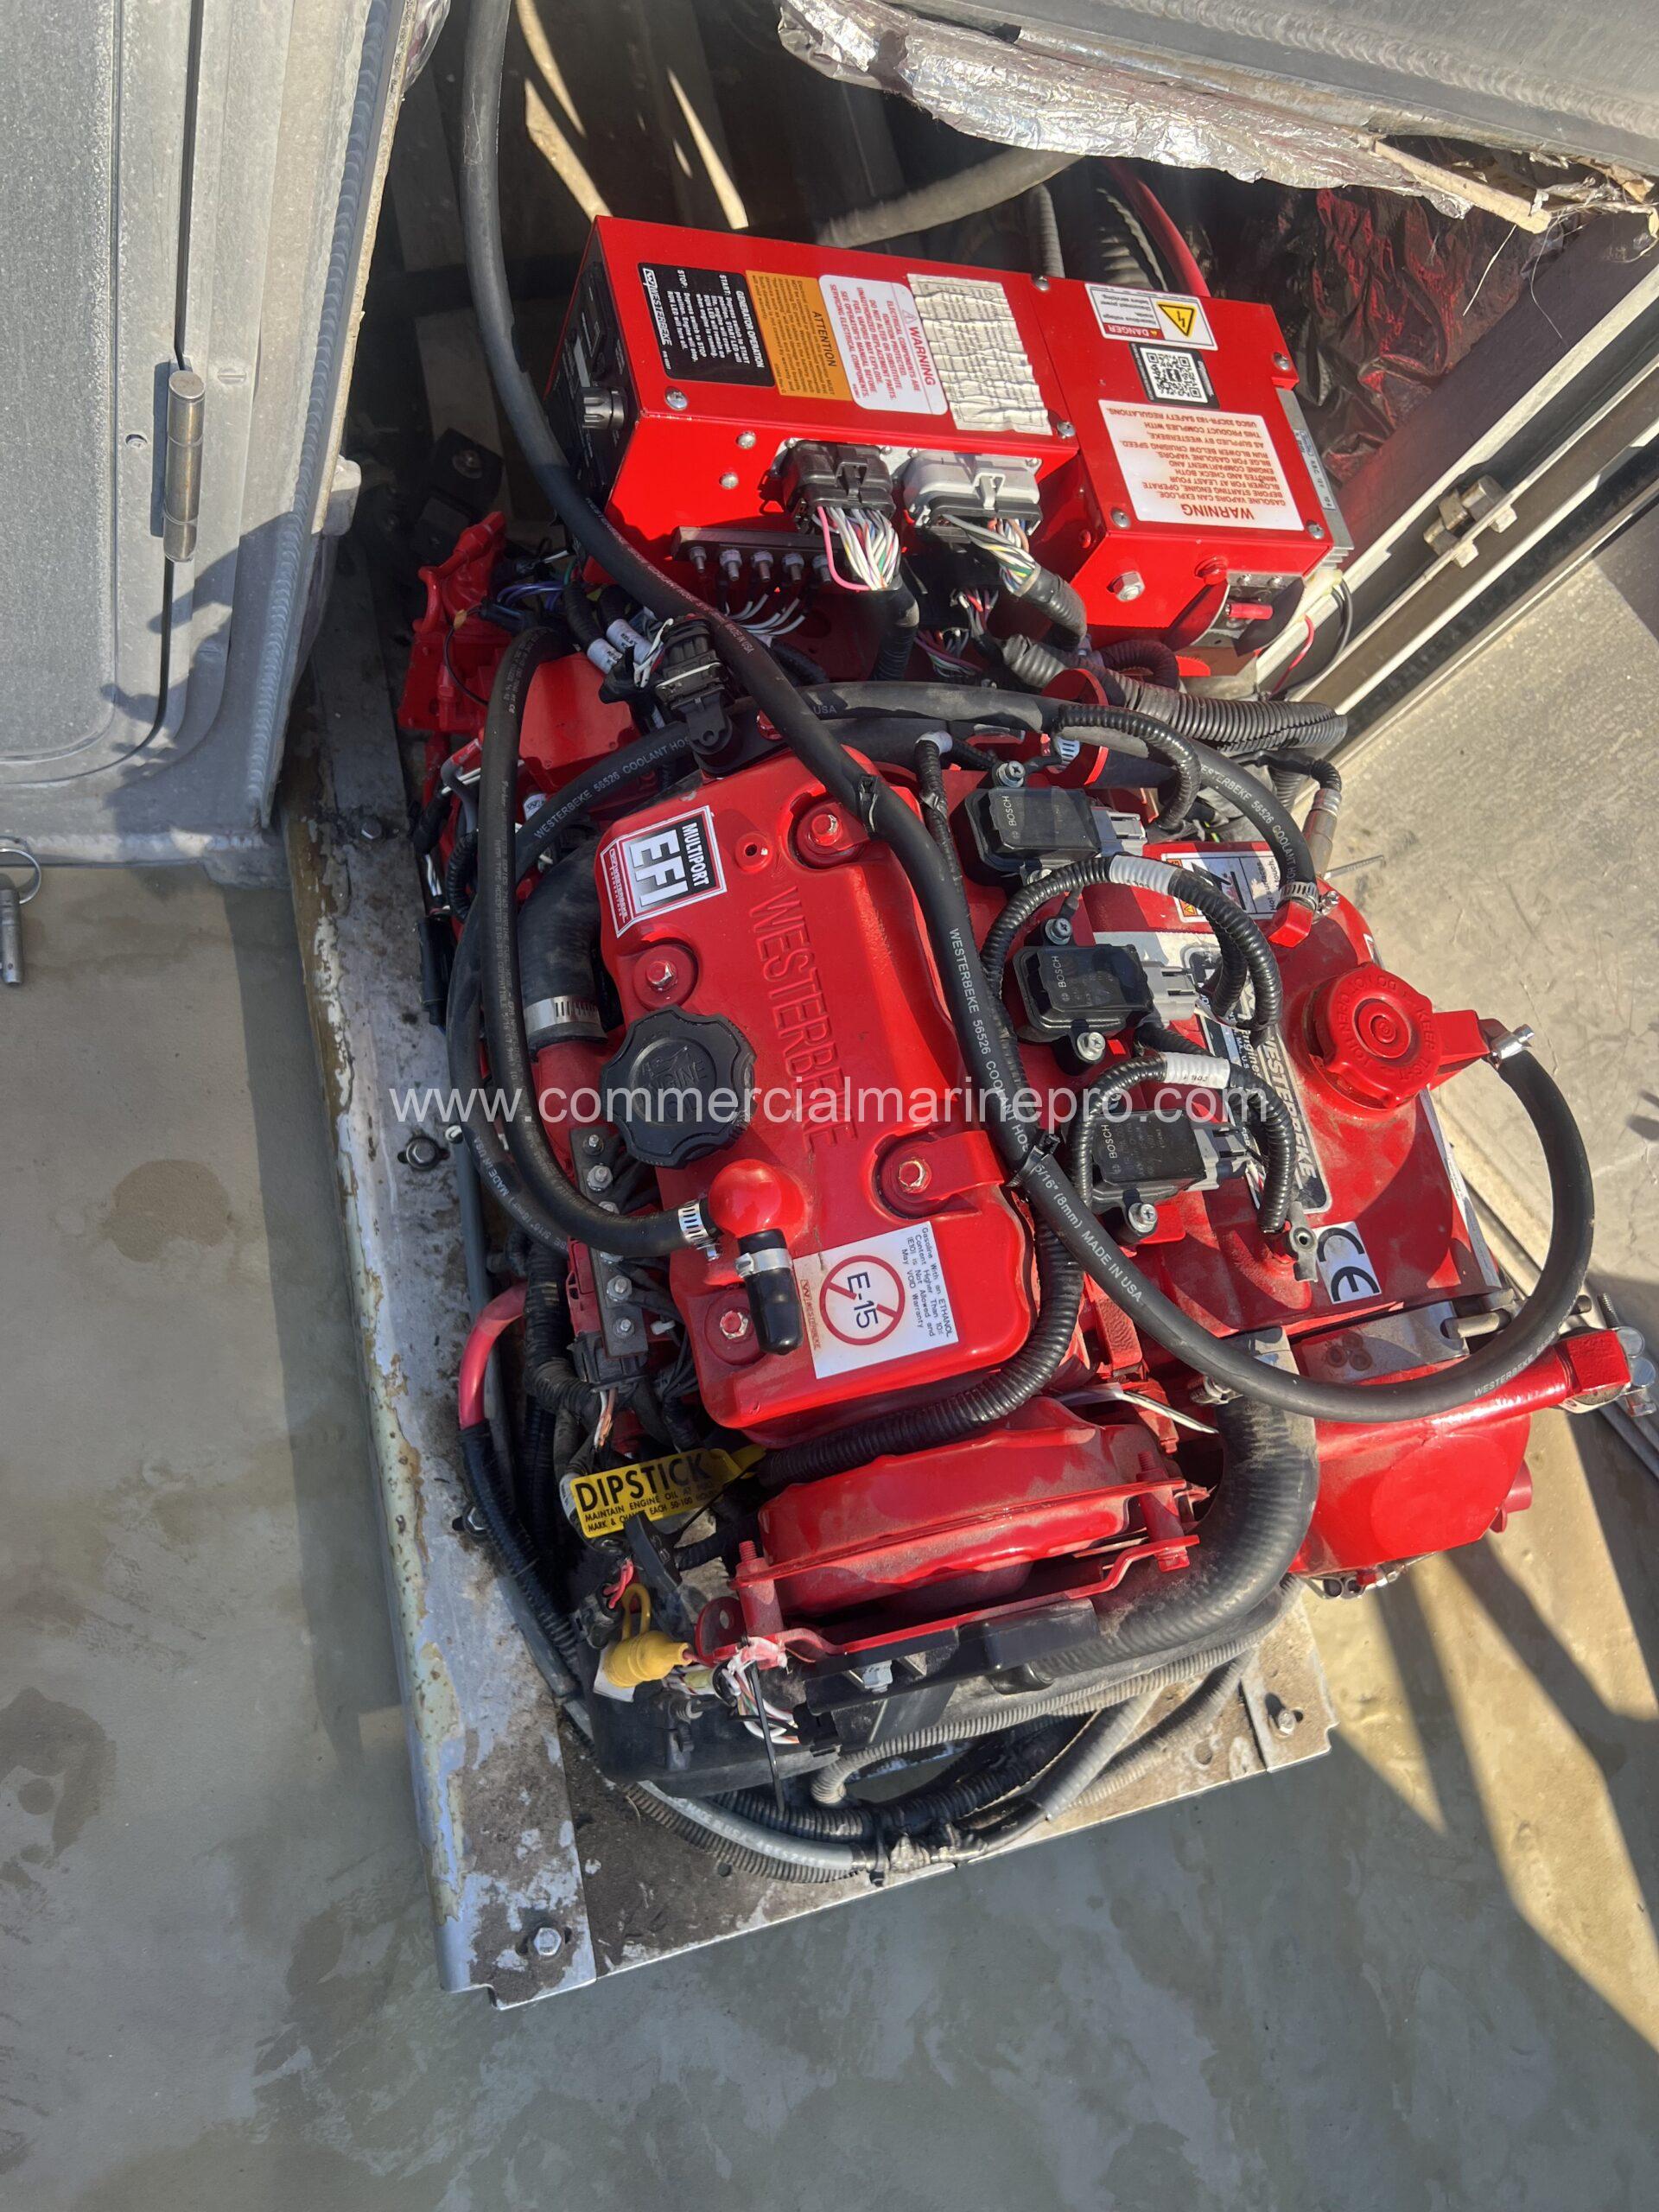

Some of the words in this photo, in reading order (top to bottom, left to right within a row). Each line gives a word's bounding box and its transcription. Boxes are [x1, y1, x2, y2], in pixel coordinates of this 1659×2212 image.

[667, 290, 676, 302] RUN
[671, 304, 679, 315] LED
[648, 287, 672, 346] WESTERBEKE
[677, 270, 687, 288] STOP:
[683, 292, 694, 315] Depress
[690, 315, 699, 334] switch
[696, 342, 707, 357] STOP
[682, 316, 691, 335] Engine
[700, 308, 709, 327] engine
[707, 308, 715, 319] LED
[714, 331, 722, 349] remain
[714, 307, 723, 326] engine
[719, 275, 731, 296] START:
[726, 297, 736, 318] Depress
[732, 320, 741, 337] switch
[737, 345, 749, 364] START
[725, 321, 735, 339] START
[736, 290, 753, 329] GENERATOR
[747, 330, 764, 367] OPERATION
[830, 284, 844, 315] SERVICING
[840, 316, 855, 352] ELECTRICAL
[882, 314, 895, 340] IGNITION
[1107, 324, 1149, 336] DANGER
[812, 311, 836, 366] ATTENTION
[857, 288, 876, 333] UNAUTHORIZED
[871, 334, 890, 377] REPLACEMENT
[857, 316, 869, 340] VAPORS
[865, 341, 874, 354] MAY
[877, 323, 887, 340] ALTER
[883, 342, 890, 351] OR
[887, 301, 902, 334] ELECTRICAL
[899, 337, 915, 378] COMPONENTS
[856, 342, 868, 366] MANUAL
[864, 369, 876, 391] BEFORE
[886, 353, 901, 387] SUBSTITUTE
[909, 327, 936, 385] WARNING
[1166, 423, 1205, 433] COMPLIES
[1207, 428, 1243, 436] PRODUCT
[1216, 438, 1253, 448] SUPPLIED
[1150, 442, 1187, 452] CRUISING
[1191, 454, 1230, 463] GASOLINE
[1187, 462, 1244, 472] COMPARTMENT
[1243, 474, 1277, 482] MINUTES
[1142, 482, 1179, 491] OPERATE
[1213, 487, 1251, 496] STARTING
[1180, 504, 1255, 519] WARNING
[724, 622, 741, 637] MADE
[742, 640, 754, 654] USA
[811, 703, 837, 715] USA
[534, 790, 594, 840] WESTERBEKE
[594, 771, 620, 791] 56526
[622, 746, 669, 774] COOLANT
[1001, 794, 1019, 828] BOSCH
[1251, 800, 1274, 824] 56526
[1272, 824, 1297, 868] COOLANT
[628, 830, 688, 906] EFI
[682, 823, 709, 887] MULTIPORT
[1049, 955, 1067, 989] BOSCH
[748, 885, 858, 1150] WESTERBEKE
[948, 926, 982, 1014] WESTERBEKE
[970, 1019, 992, 1055] 56526
[1053, 1189, 1087, 1230] (8mm)
[1081, 1230, 1115, 1266] MADE
[1108, 1257, 1124, 1279] IN
[1119, 1273, 1143, 1304] USA
[474, 1135, 487, 1157] USA
[1104, 1122, 1124, 1160] BOSCH
[488, 1166, 510, 1198] MADE
[915, 1234, 926, 1265] Content
[923, 1269, 933, 1293] Higher
[1317, 1225, 1378, 1303] CE
[906, 1269, 916, 1289] VOID
[912, 1293, 924, 1327] Warranty
[922, 1227, 933, 1258] Gasoline
[935, 1285, 941, 1294] an
[938, 1298, 952, 1338] ETHANOL
[847, 1272, 878, 1328] E-15
[919, 1290, 931, 1318] Allowed
[926, 1322, 936, 1337] and
[804, 1300, 821, 1350] WESTERBEKE
[575, 1452, 711, 1512] DIPSTICK
[584, 1503, 625, 1522] MAINTAIN
[629, 1495, 660, 1510] ENGINE
[664, 1491, 678, 1501] OIL
[588, 1519, 607, 1532] MARK
[649, 1503, 668, 1516] EACH
[670, 1497, 694, 1510] 50-100
